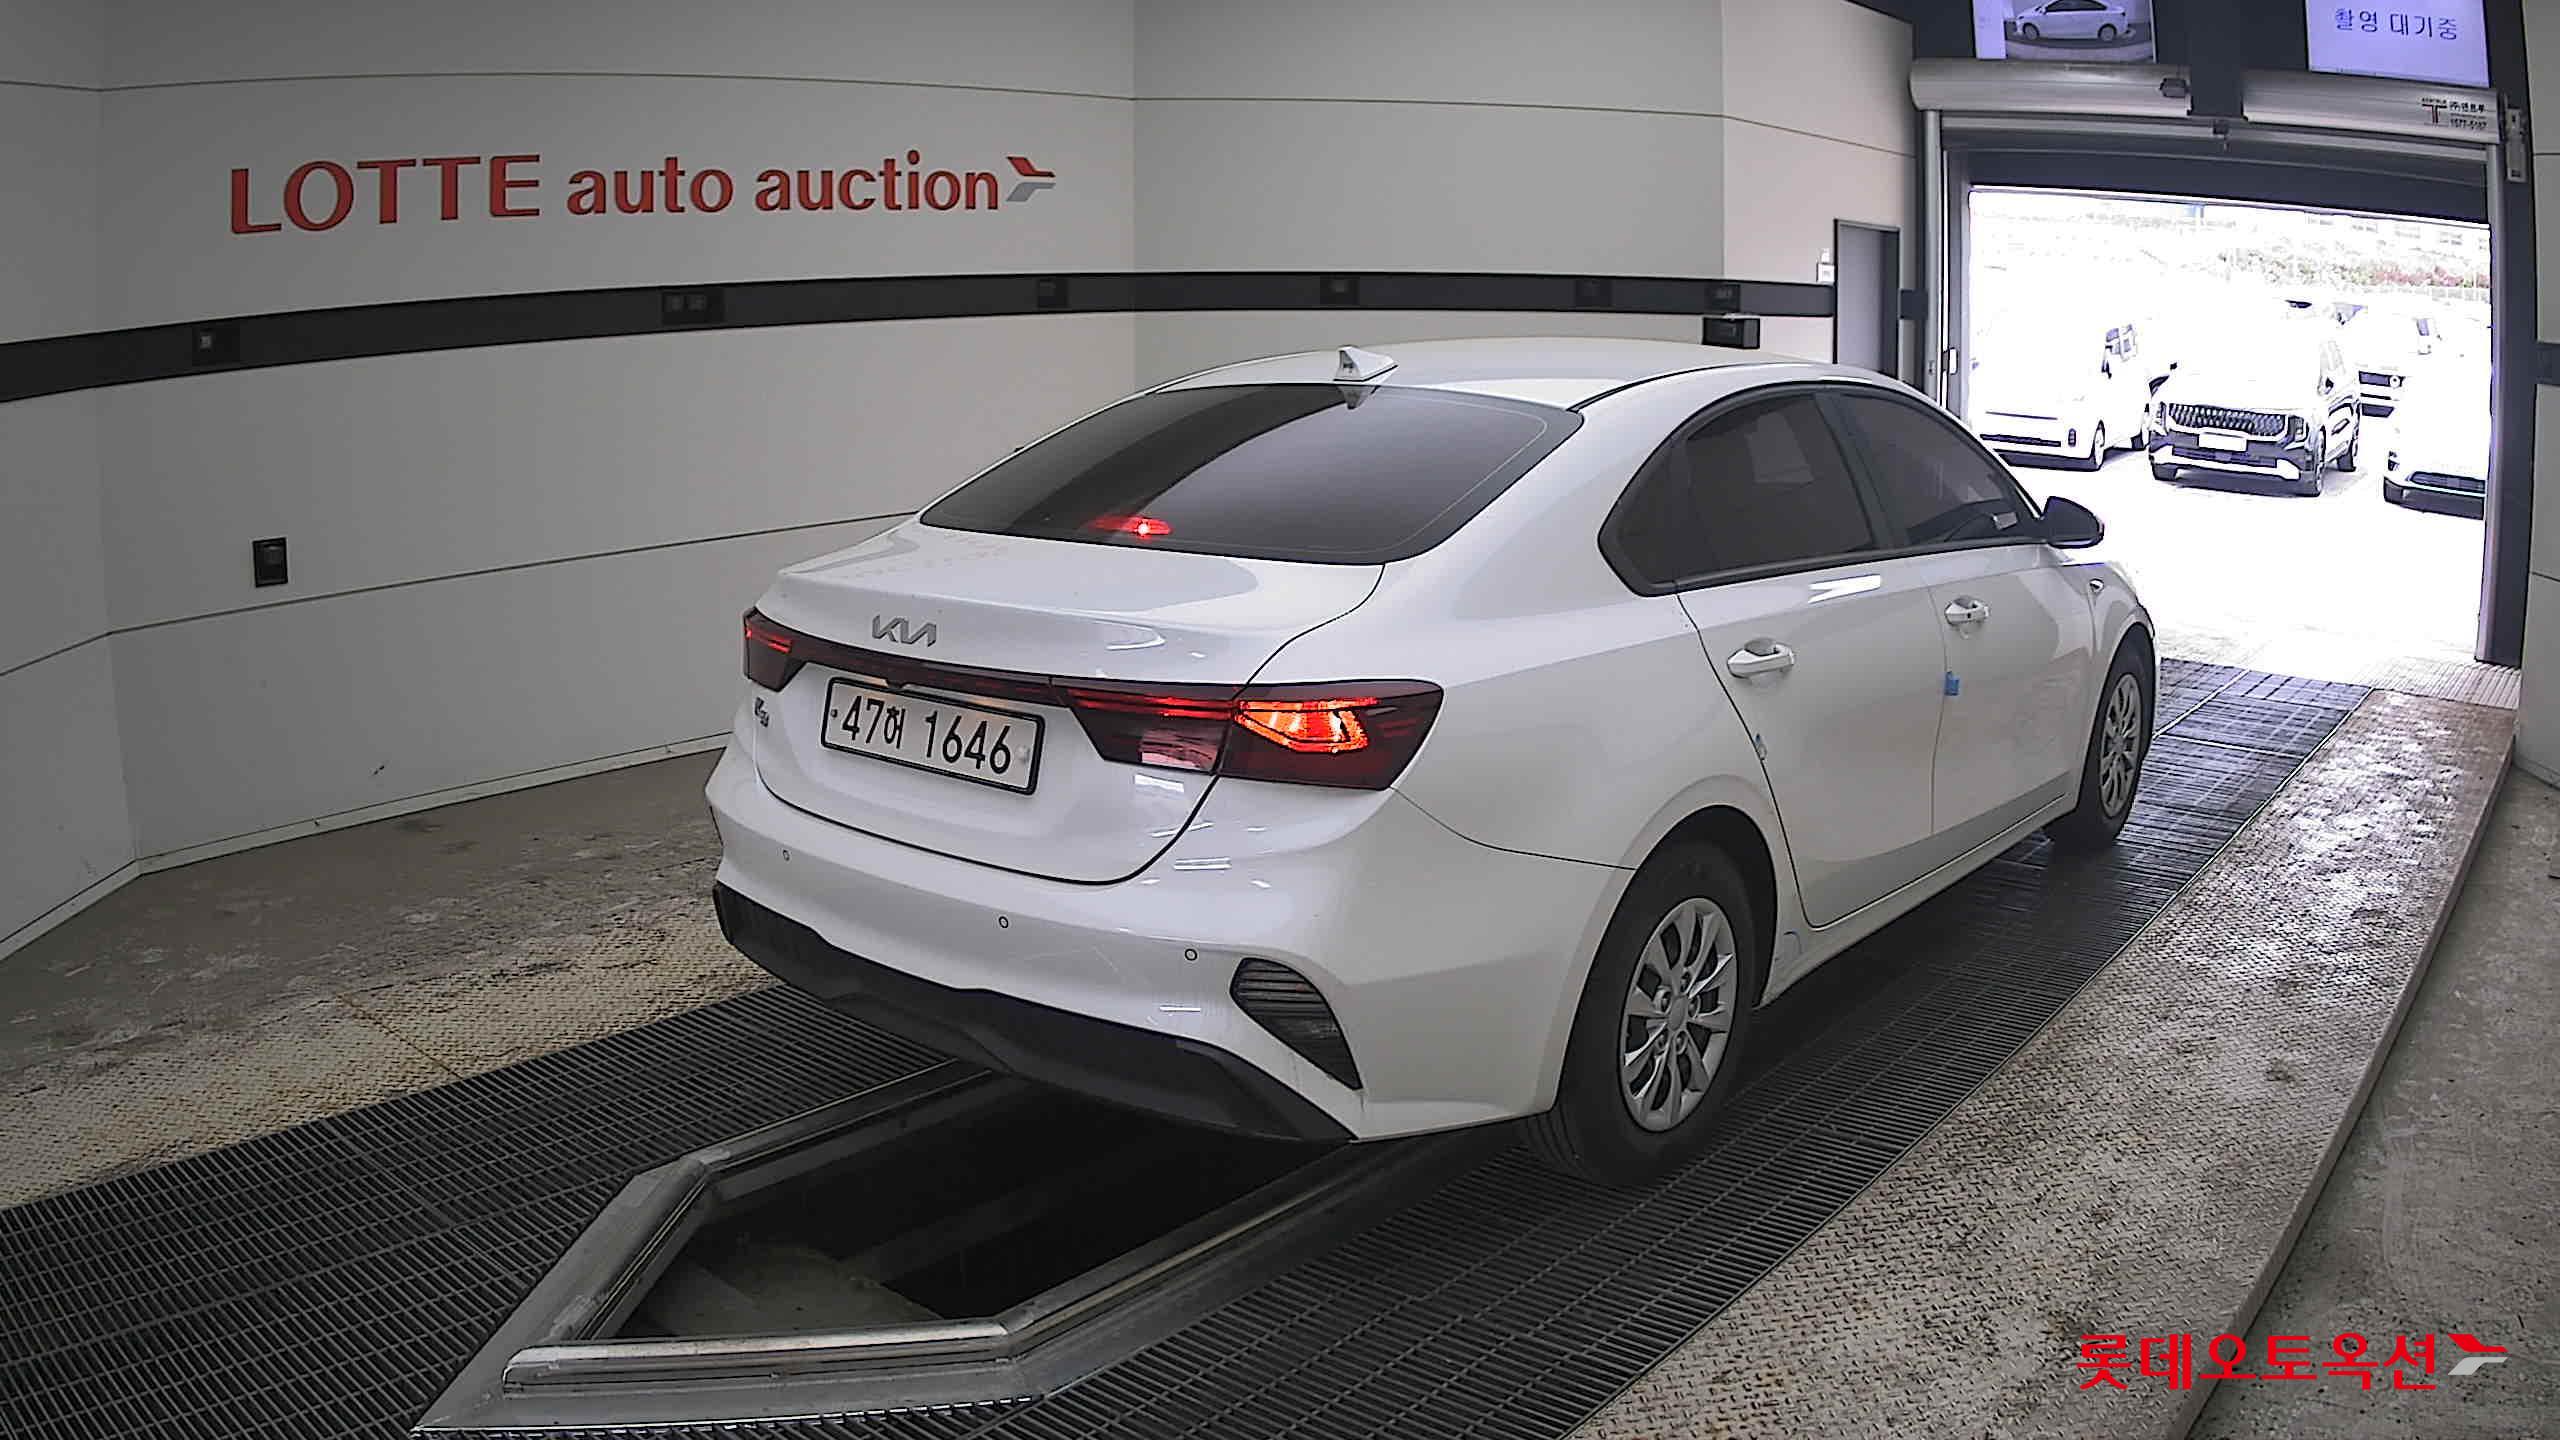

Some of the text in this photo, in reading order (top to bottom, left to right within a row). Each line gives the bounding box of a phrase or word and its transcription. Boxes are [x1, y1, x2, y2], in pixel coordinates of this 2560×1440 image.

[2390, 13, 2457, 41] 대기중
[230, 150, 1000, 234] LOTTE auto auction
[842, 696, 1011, 774] 47허 1646
